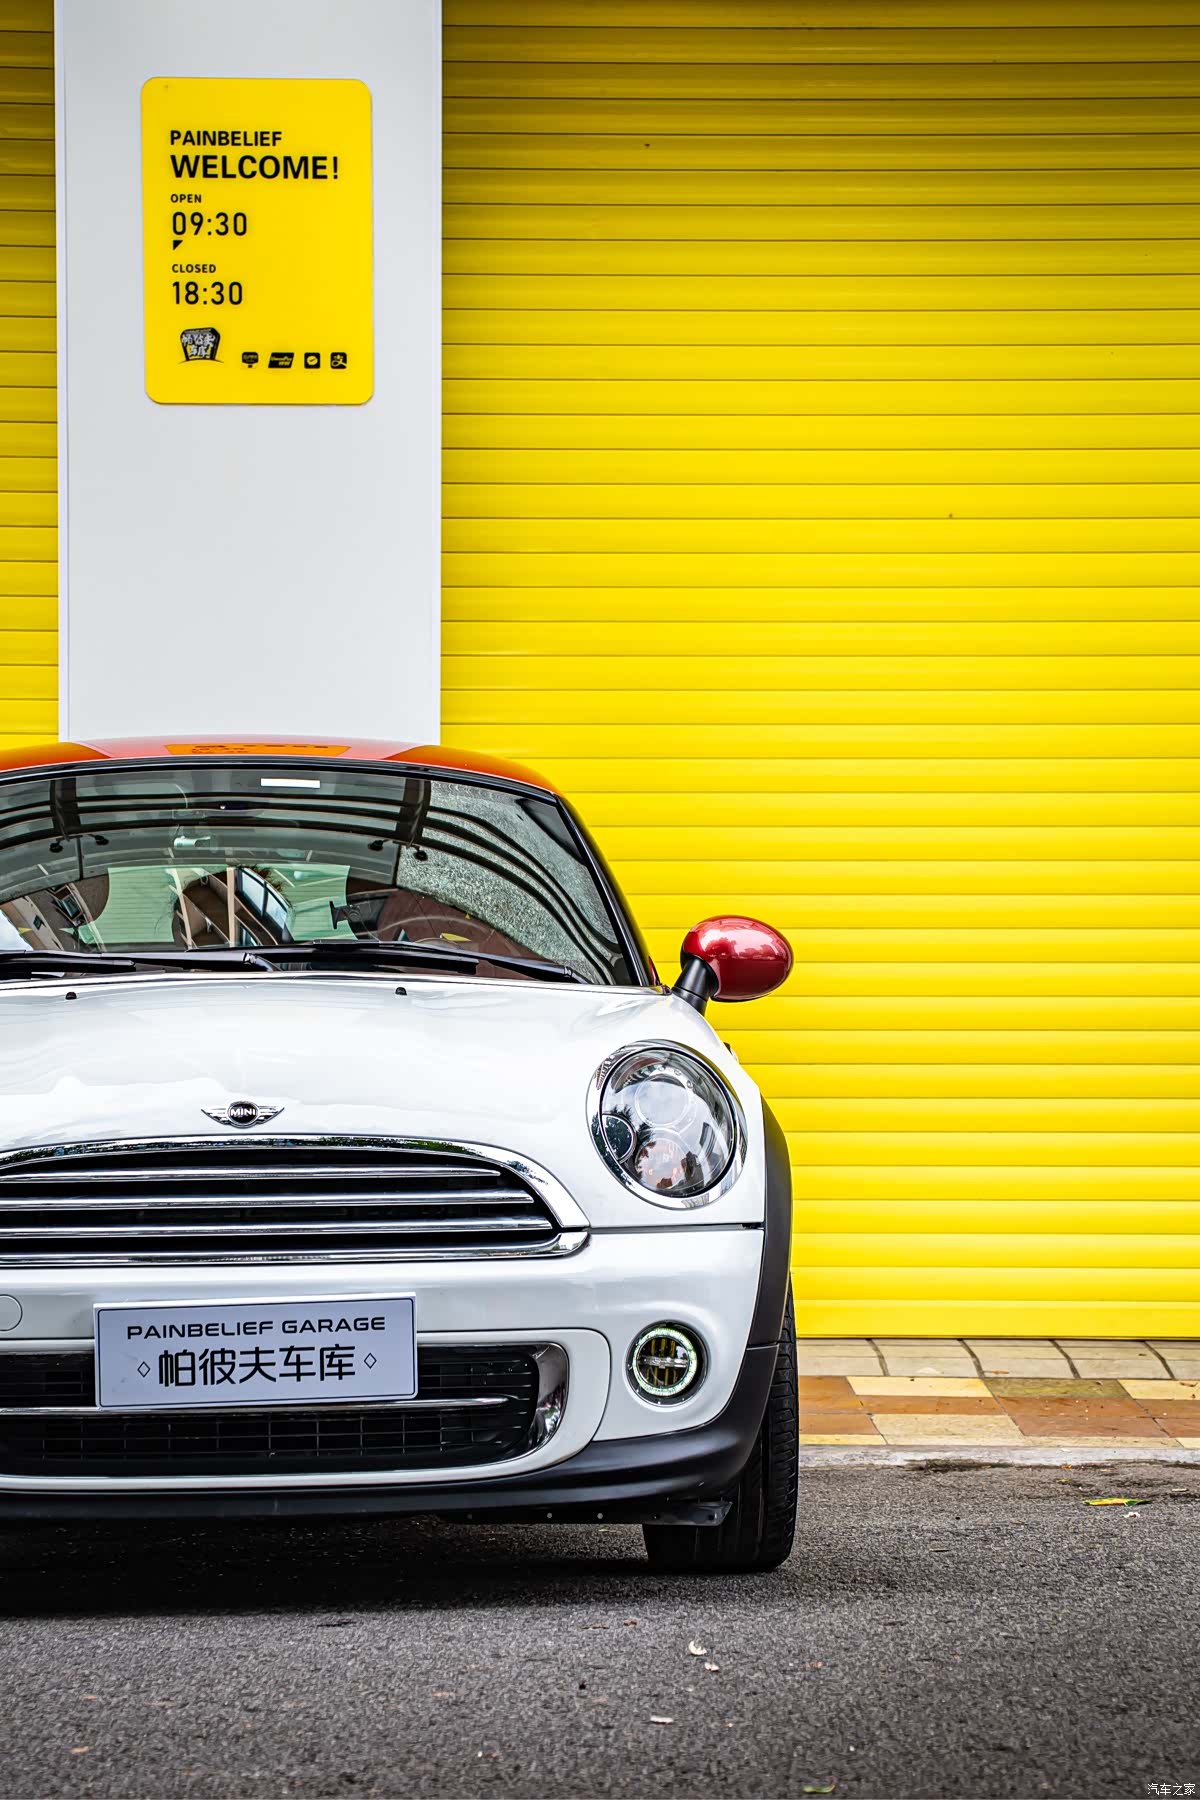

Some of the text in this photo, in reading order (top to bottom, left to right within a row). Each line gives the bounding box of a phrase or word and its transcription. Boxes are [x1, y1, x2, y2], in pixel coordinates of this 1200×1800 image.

[170, 129, 282, 148] PAINBELIEF
[170, 154, 339, 180] WELCOME!
[170, 193, 202, 204] OPEN
[172, 211, 248, 237] 09:30
[171, 263, 217, 274] CLOSED
[172, 280, 243, 306] 18:30
[230, 1108, 256, 1117] MINI
[127, 1317, 386, 1340] PAINBELIEF GARAGE
[158, 1343, 356, 1388] 帕彼夫车库
